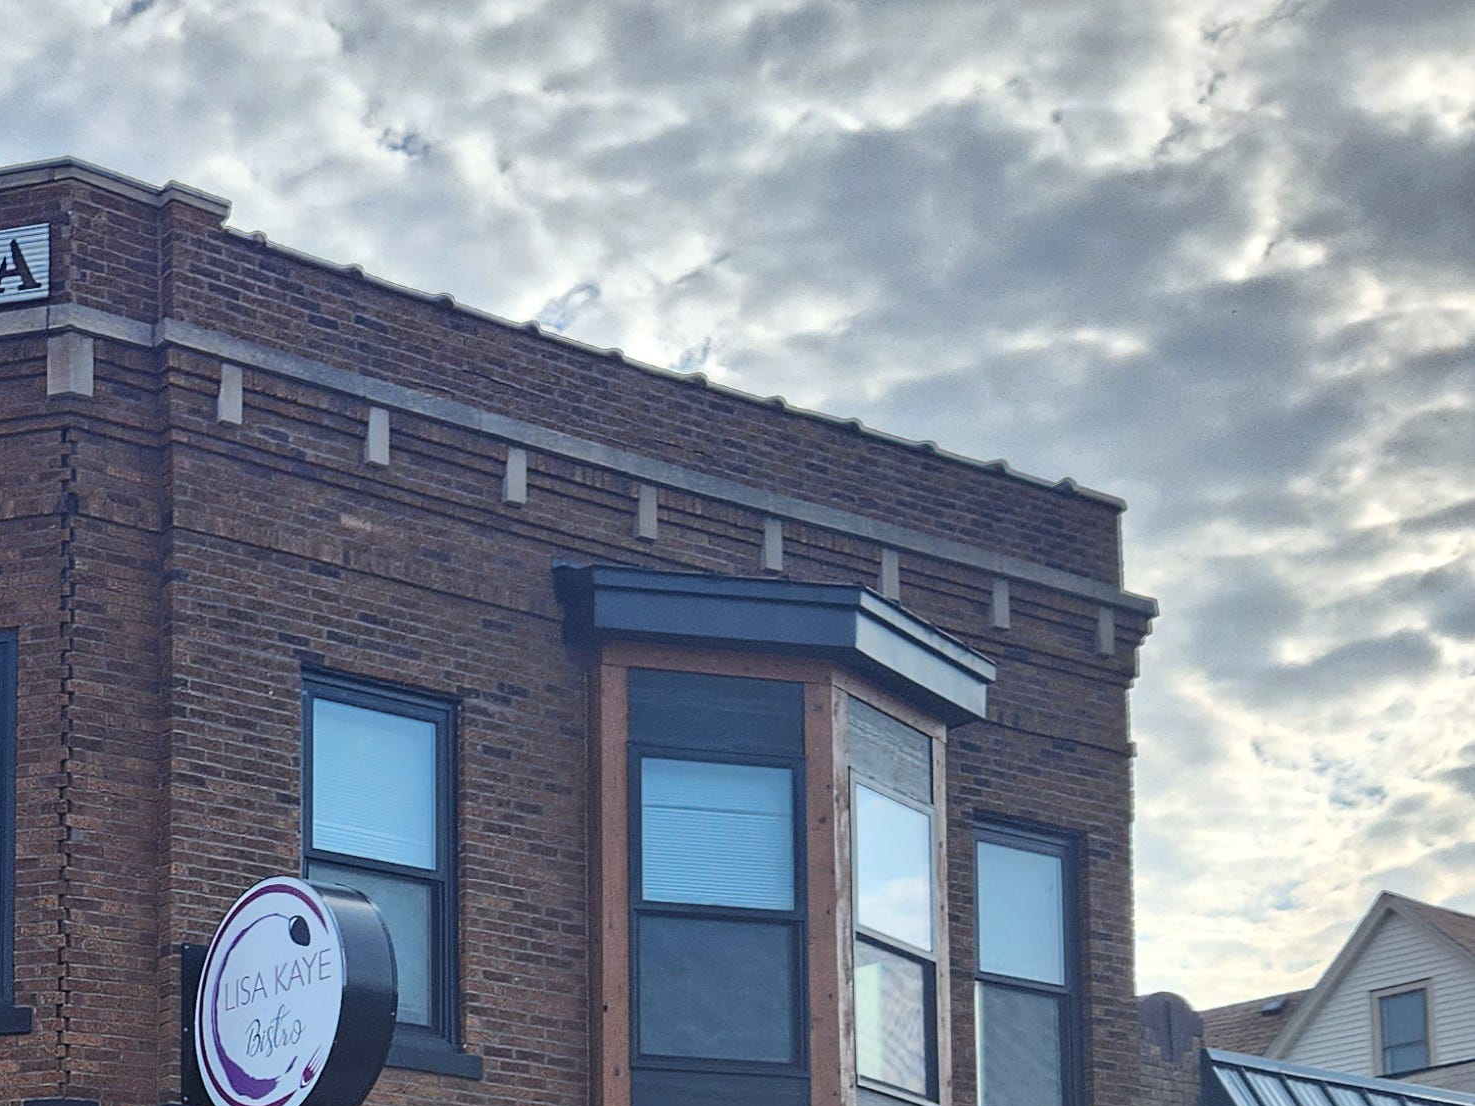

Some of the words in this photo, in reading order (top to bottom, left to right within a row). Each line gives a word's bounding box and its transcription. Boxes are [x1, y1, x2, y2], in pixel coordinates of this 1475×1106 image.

[225, 972, 268, 1011] LISA
[275, 949, 332, 995] KAYE
[245, 1004, 307, 1058] Bistro
